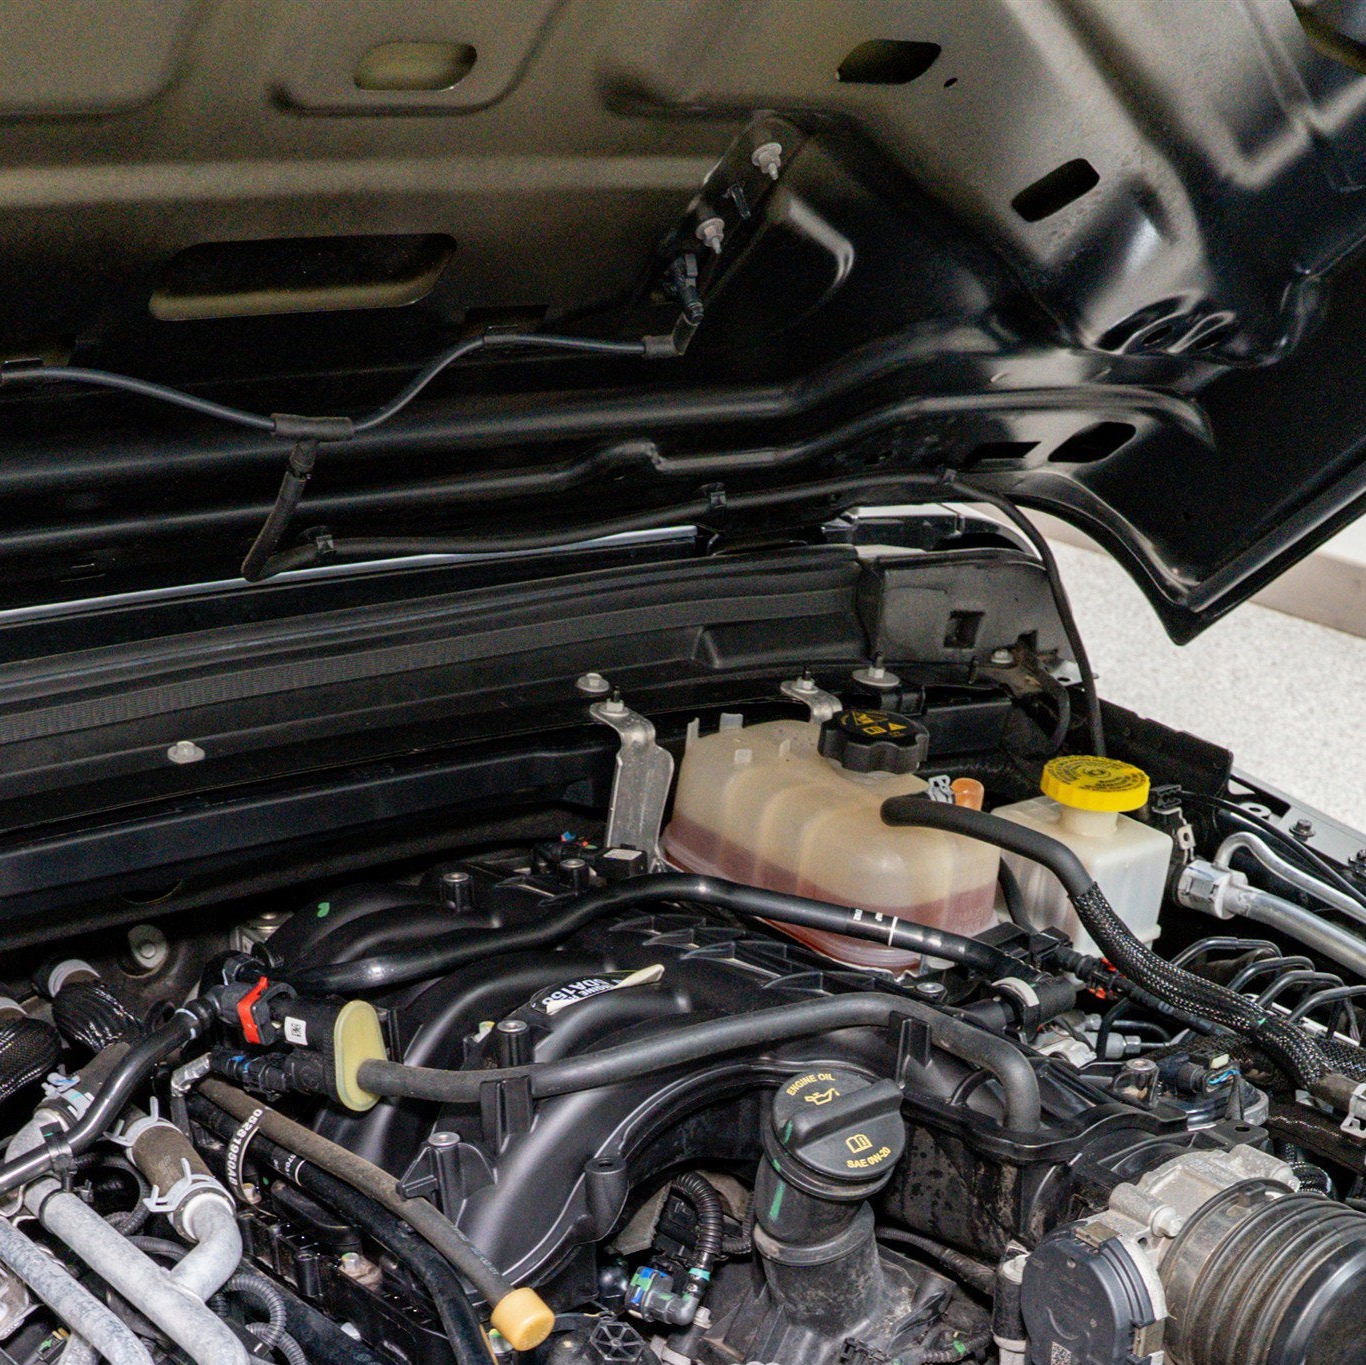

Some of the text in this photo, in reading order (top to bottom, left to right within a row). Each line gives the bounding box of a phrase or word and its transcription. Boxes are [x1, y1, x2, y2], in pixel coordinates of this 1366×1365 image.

[785, 1073, 836, 1096] ENGINE OIL
[846, 1146, 891, 1168] SAE 0W-20
